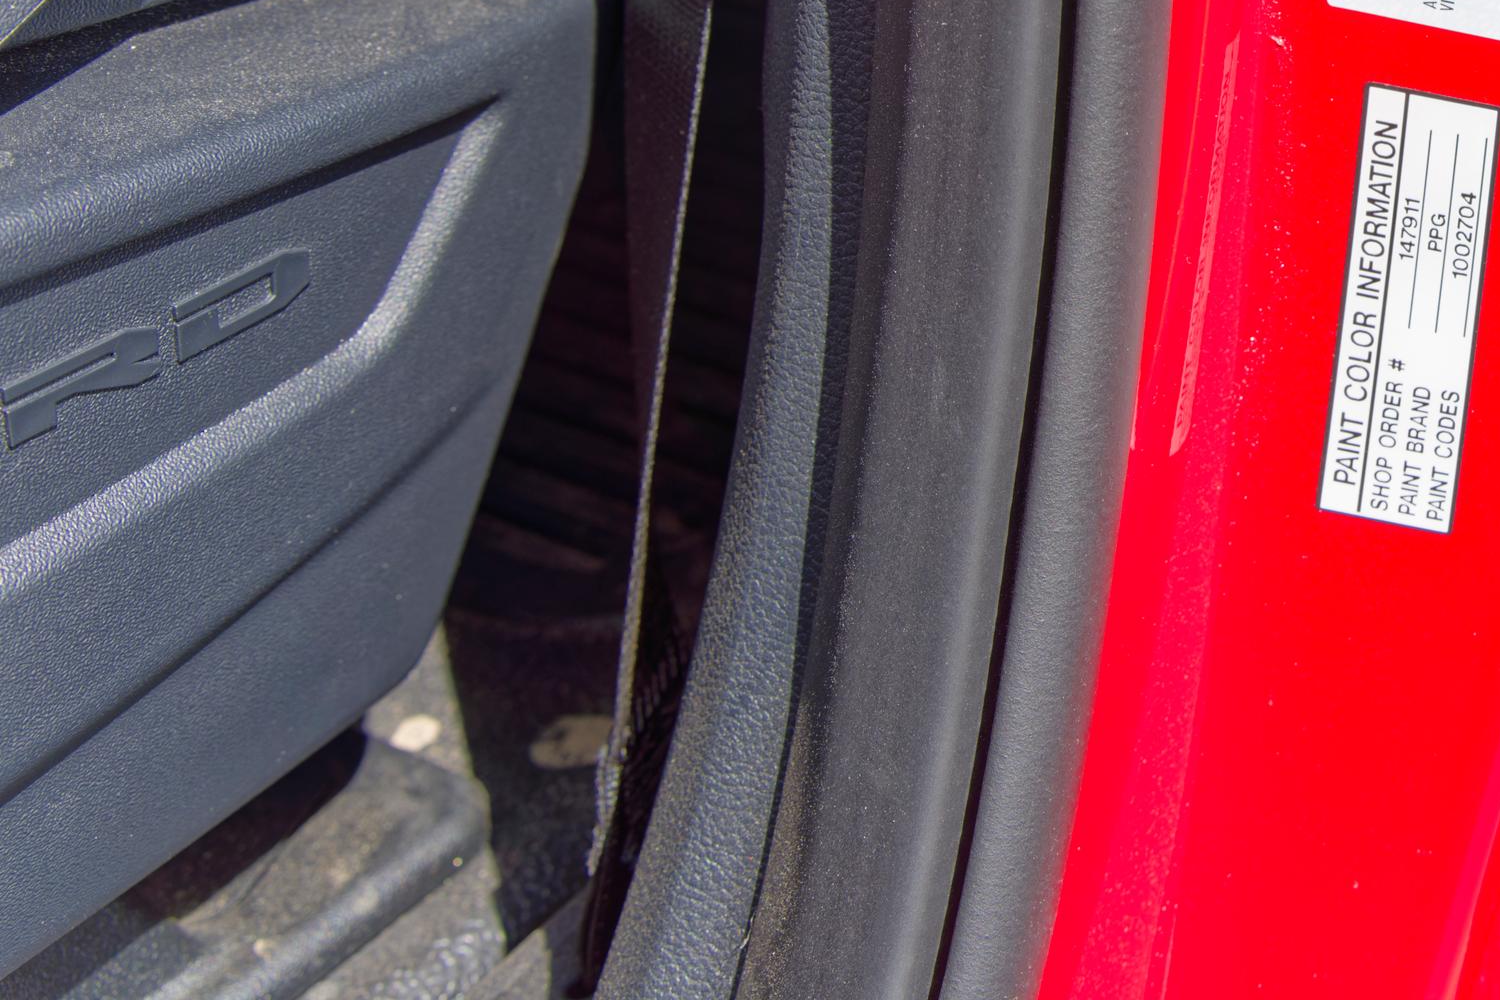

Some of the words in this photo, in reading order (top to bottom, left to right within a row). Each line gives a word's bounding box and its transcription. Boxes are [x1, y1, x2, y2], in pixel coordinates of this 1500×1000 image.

[1356, 120, 1398, 300] INFORMATION
[1399, 198, 1420, 260] 147911
[1427, 214, 1446, 252] PPG
[1452, 192, 1476, 278] 1002704
[1344, 311, 1377, 402] COLOR
[1389, 358, 1405, 372] #
[1378, 381, 1403, 448] ORDER
[1406, 387, 1431, 454] BRAND
[1434, 390, 1460, 458] CODES
[1333, 412, 1363, 485] PAINT
[1370, 457, 1392, 511] SHOP
[1398, 460, 1421, 516] PAINT
[1426, 466, 1449, 521] PAINT
